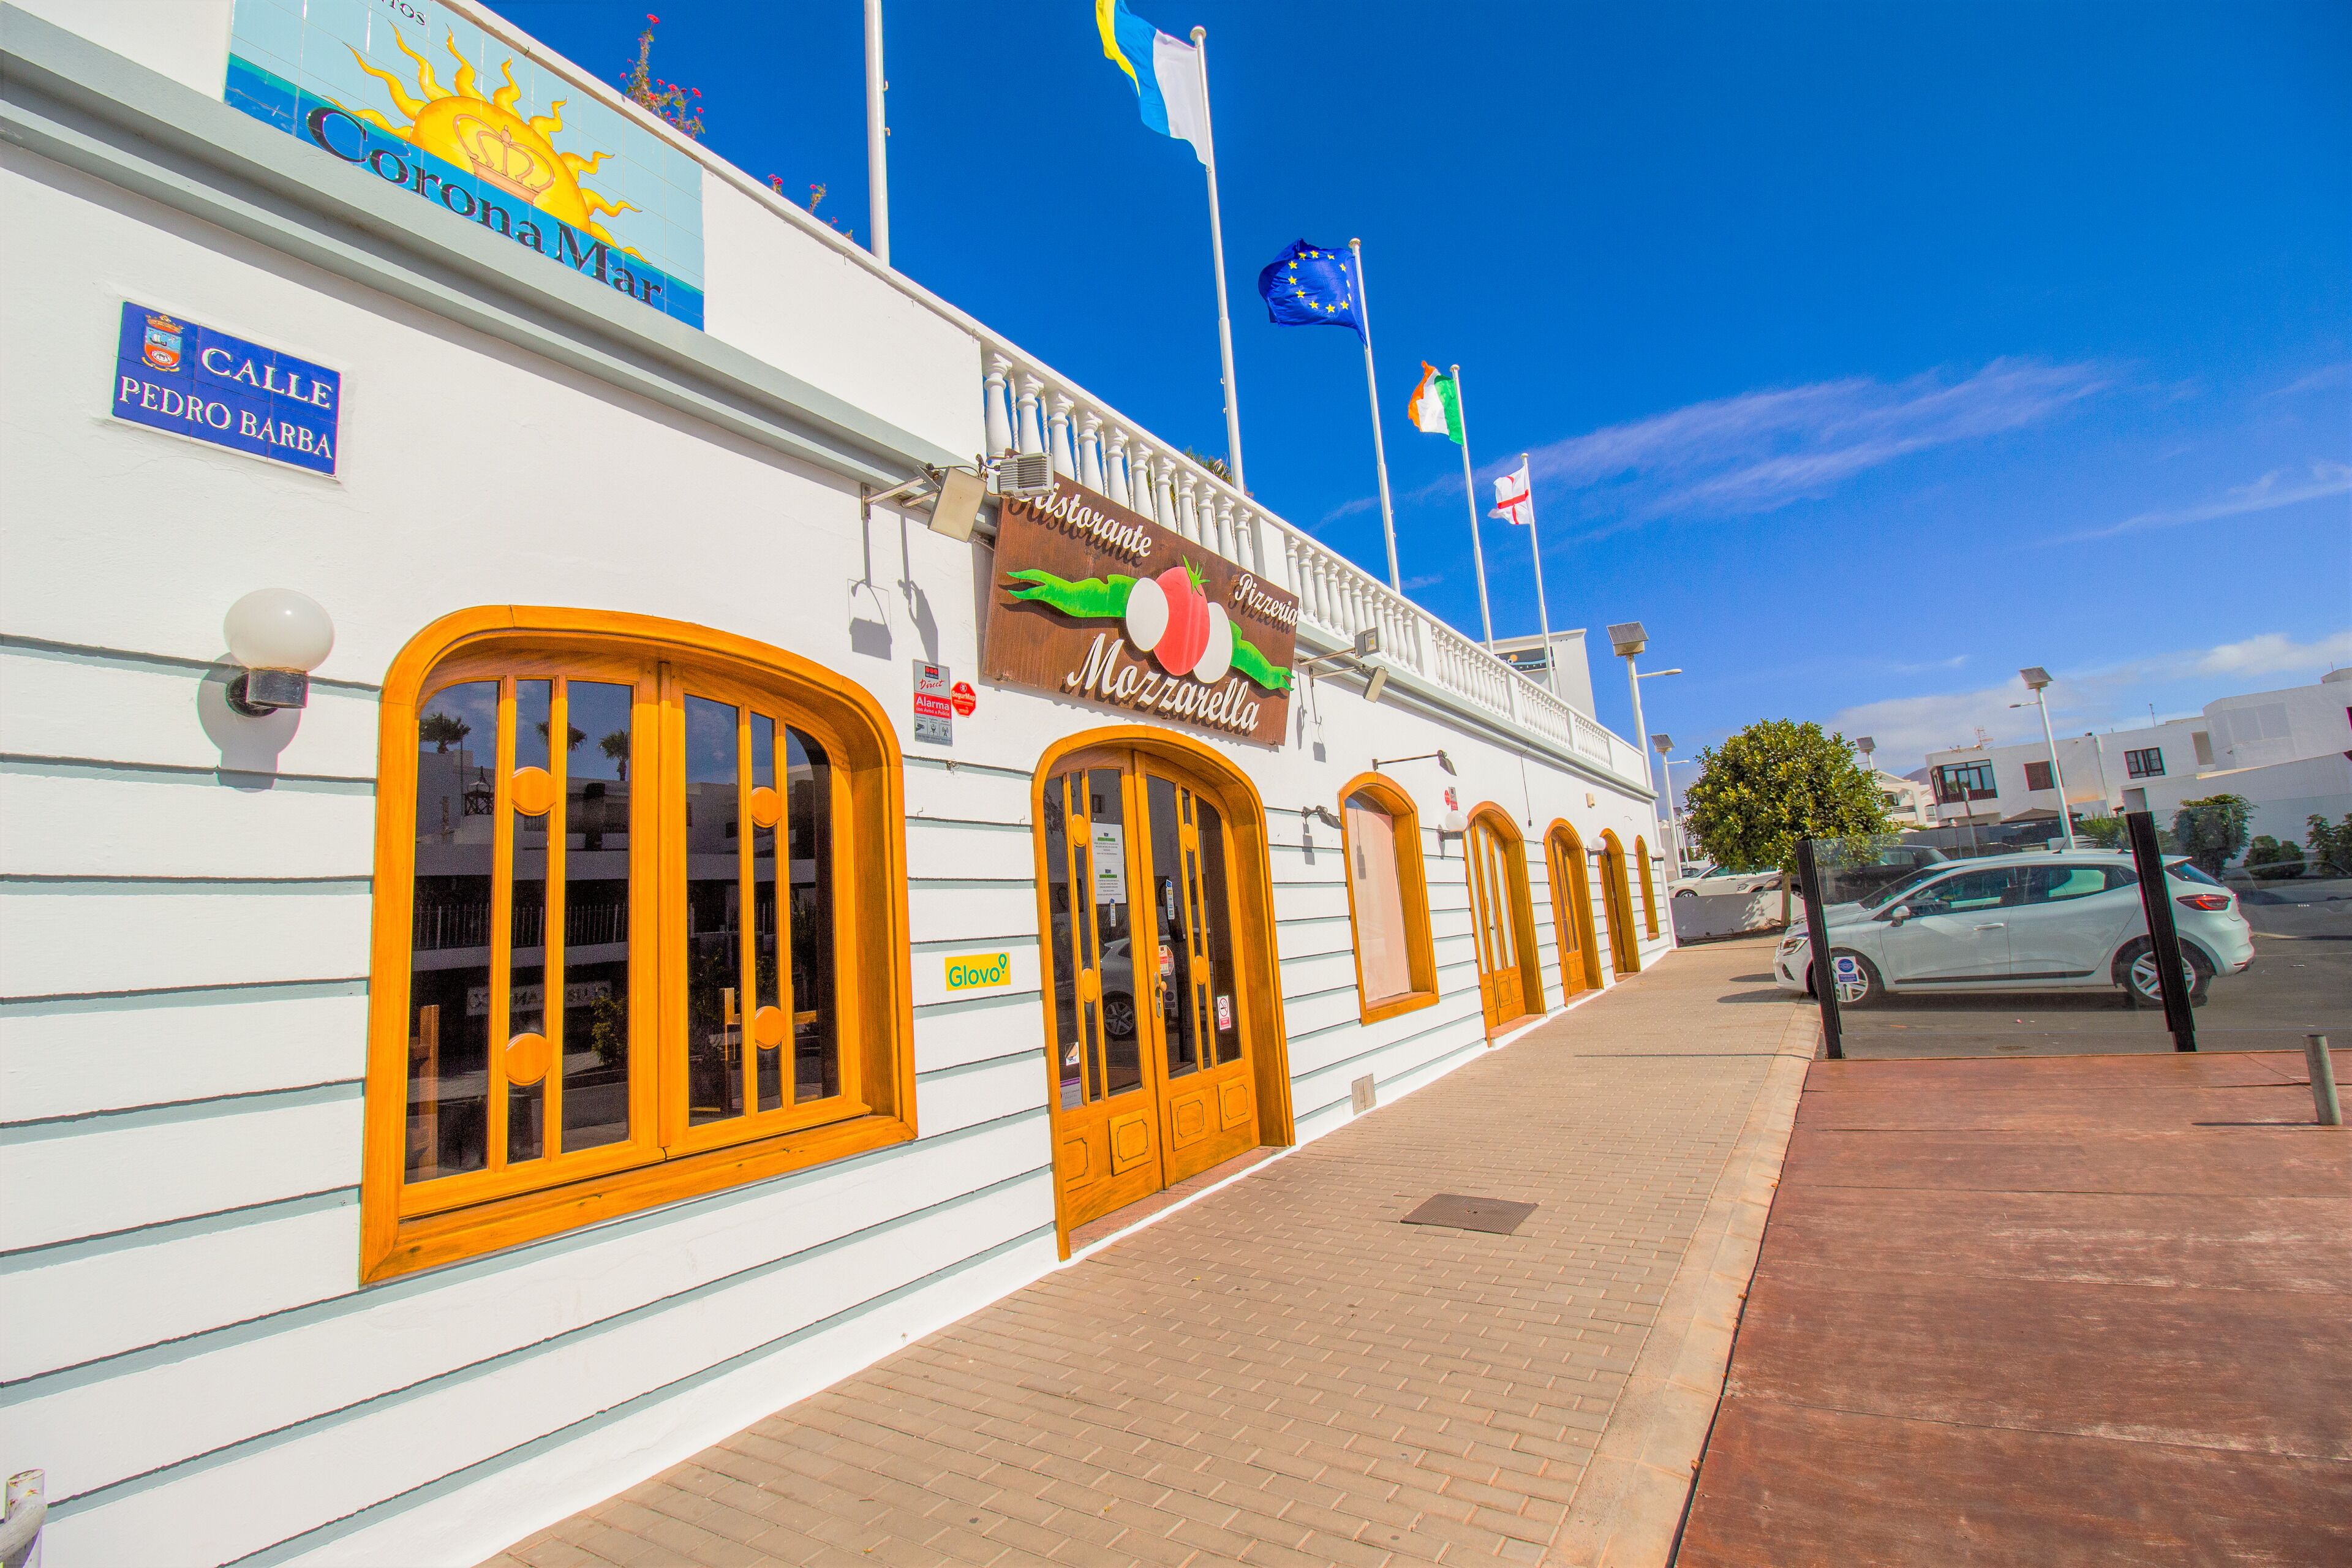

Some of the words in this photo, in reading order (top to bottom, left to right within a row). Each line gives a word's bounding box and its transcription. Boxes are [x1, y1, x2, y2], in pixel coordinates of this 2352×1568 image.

[201, 347, 332, 410] CALLE
[119, 375, 232, 430] PEDRO
[239, 410, 333, 459] BARBA
[1234, 573, 1298, 627] Pizzeria
[919, 678, 945, 690] Direct
[952, 690, 976, 701] SegurMap
[1066, 633, 1260, 731] Mozzarella
[916, 696, 949, 710] Alarma
[949, 965, 1000, 987] Glovo
